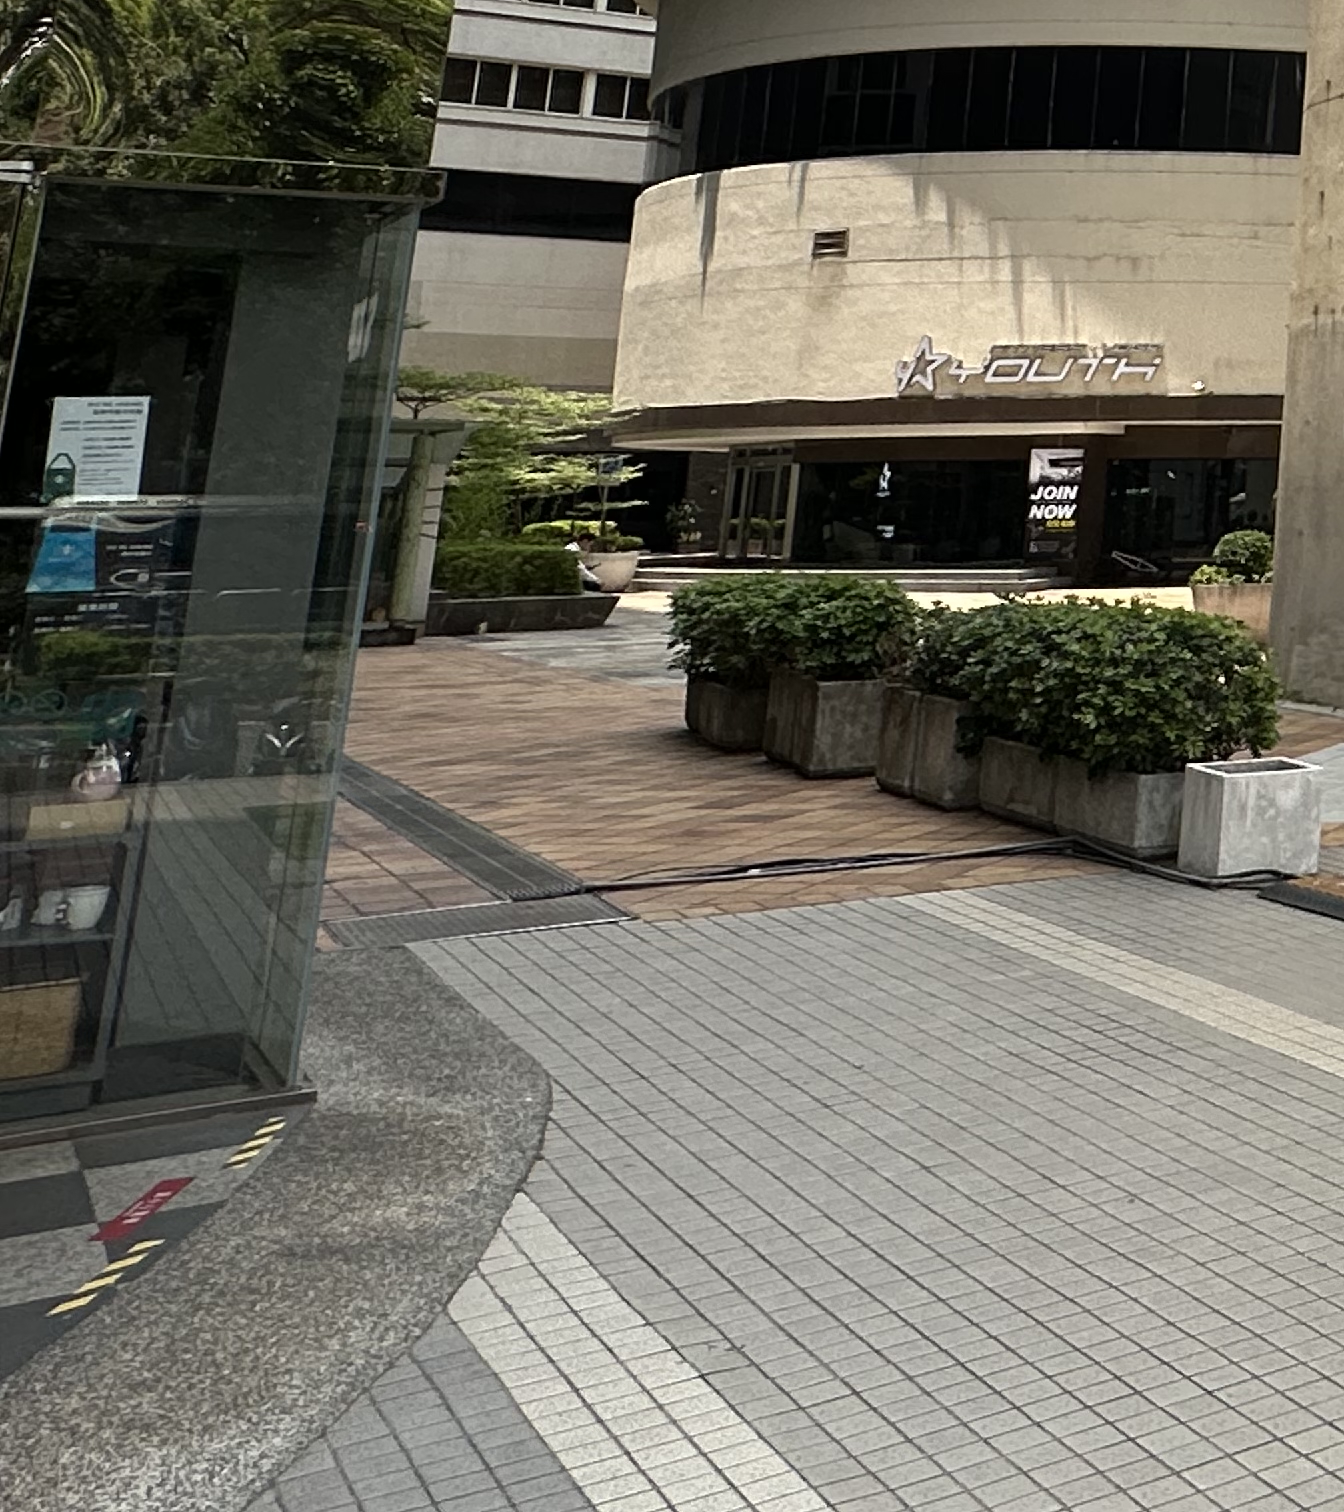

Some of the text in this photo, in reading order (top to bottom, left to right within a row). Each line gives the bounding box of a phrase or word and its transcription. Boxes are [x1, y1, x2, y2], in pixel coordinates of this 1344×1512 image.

[949, 356, 1162, 384] YOUTH
[1030, 485, 1078, 500] JOIN
[1028, 503, 1077, 519] NOW
